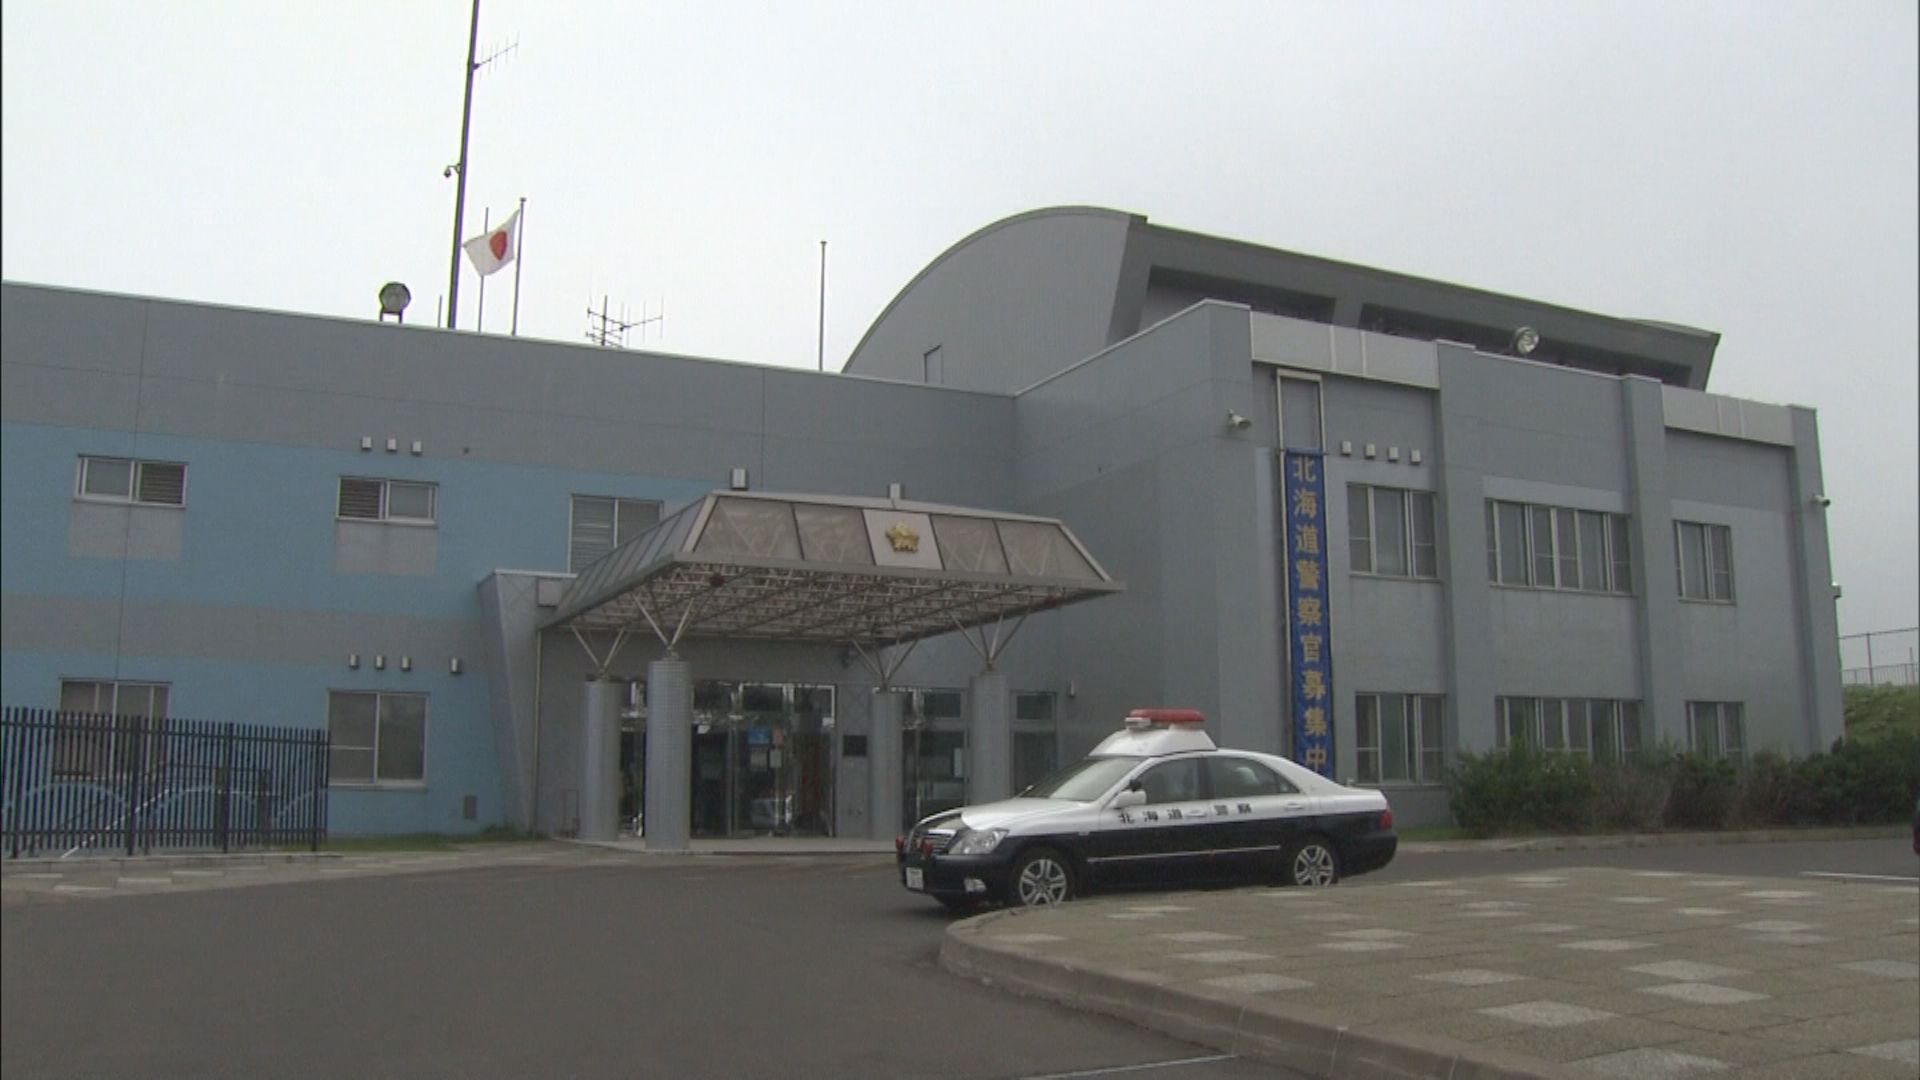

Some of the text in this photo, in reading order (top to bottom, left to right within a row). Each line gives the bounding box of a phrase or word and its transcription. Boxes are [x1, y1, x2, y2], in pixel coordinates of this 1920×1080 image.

[1293, 455, 1327, 773] 北海道警察官募集中
